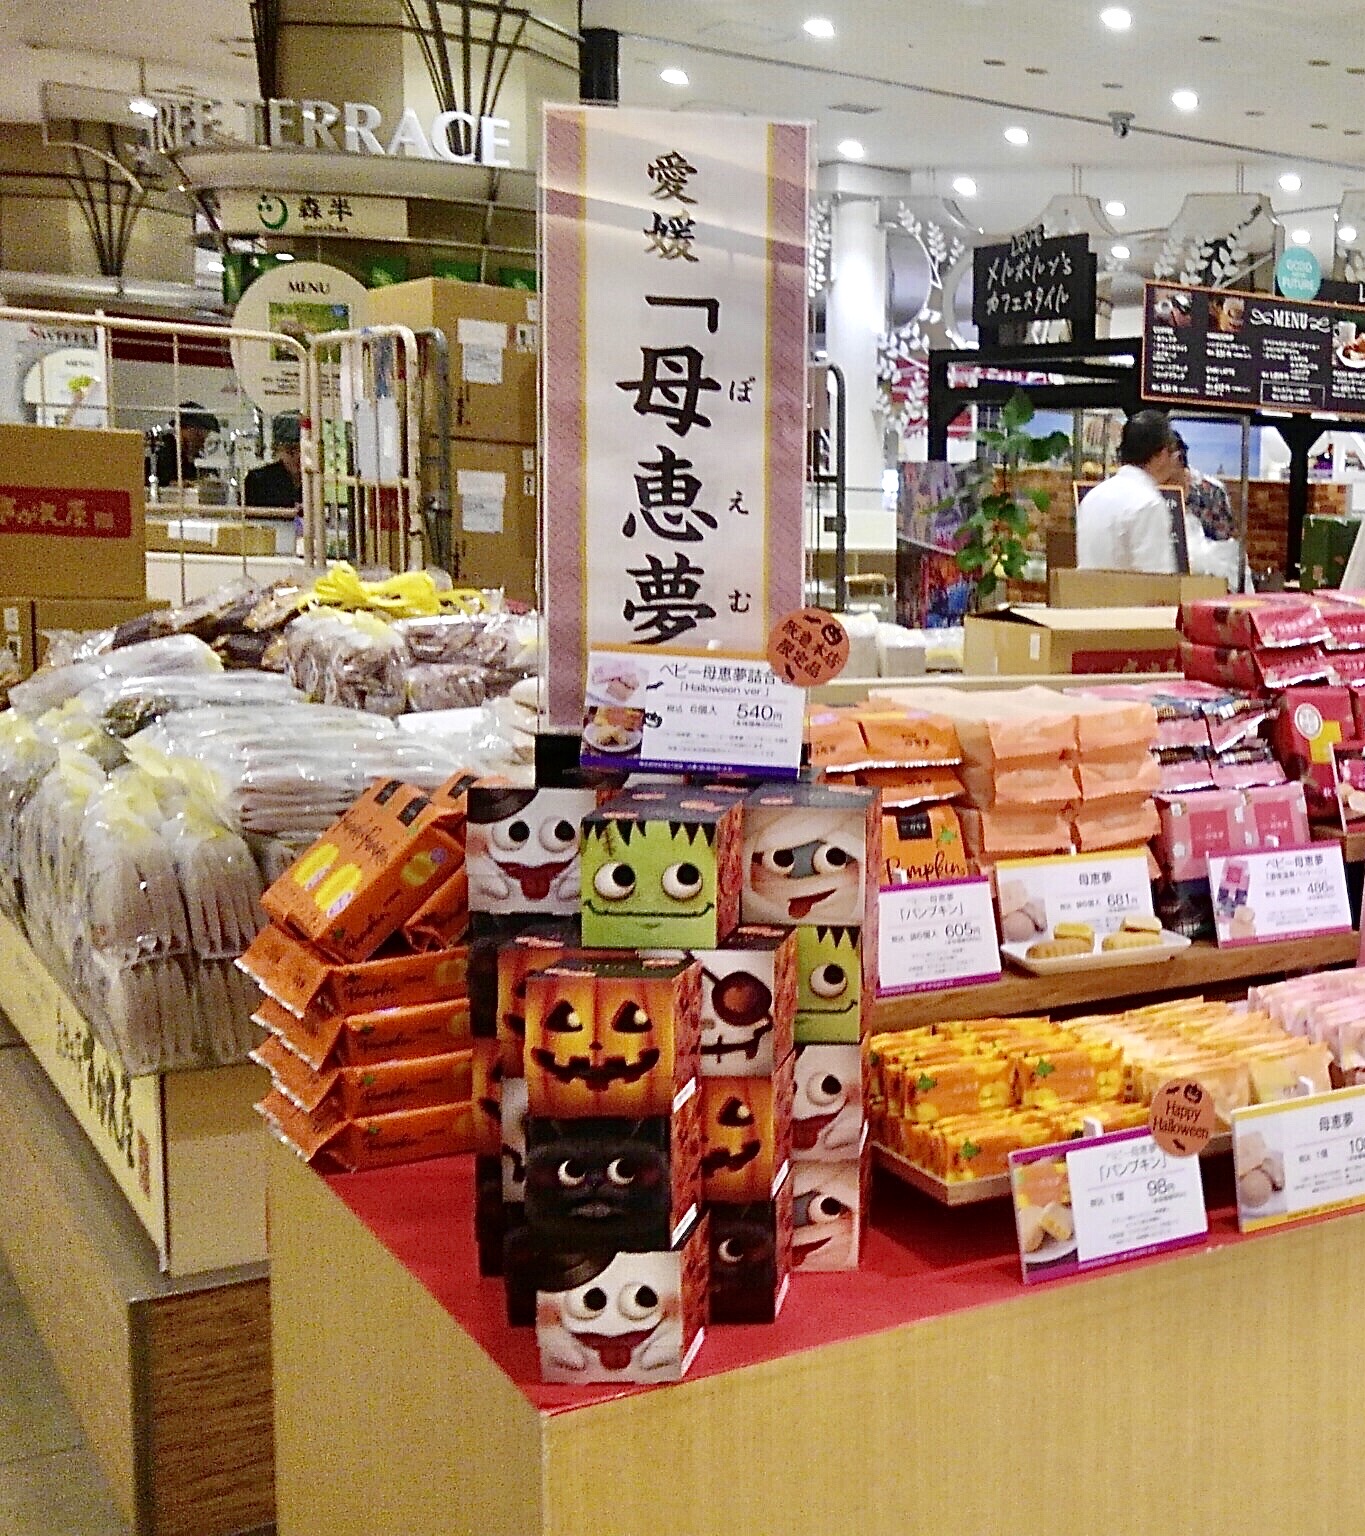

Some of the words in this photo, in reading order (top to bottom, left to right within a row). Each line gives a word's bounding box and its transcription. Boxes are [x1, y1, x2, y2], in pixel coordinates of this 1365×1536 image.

[235, 98, 512, 167] TERRACE
[299, 197, 353, 222] 森半
[643, 150, 699, 262] 愛媛
[289, 281, 331, 295] MENU
[1273, 309, 1309, 330] MENU
[660, 663, 791, 686] ベビー母恵夢詰合
[736, 704, 783, 722] 540円
[1166, 1100, 1201, 1122] Happy
[1319, 1111, 1354, 1132] 母恵夢
[1153, 1116, 1209, 1140] Halloween
